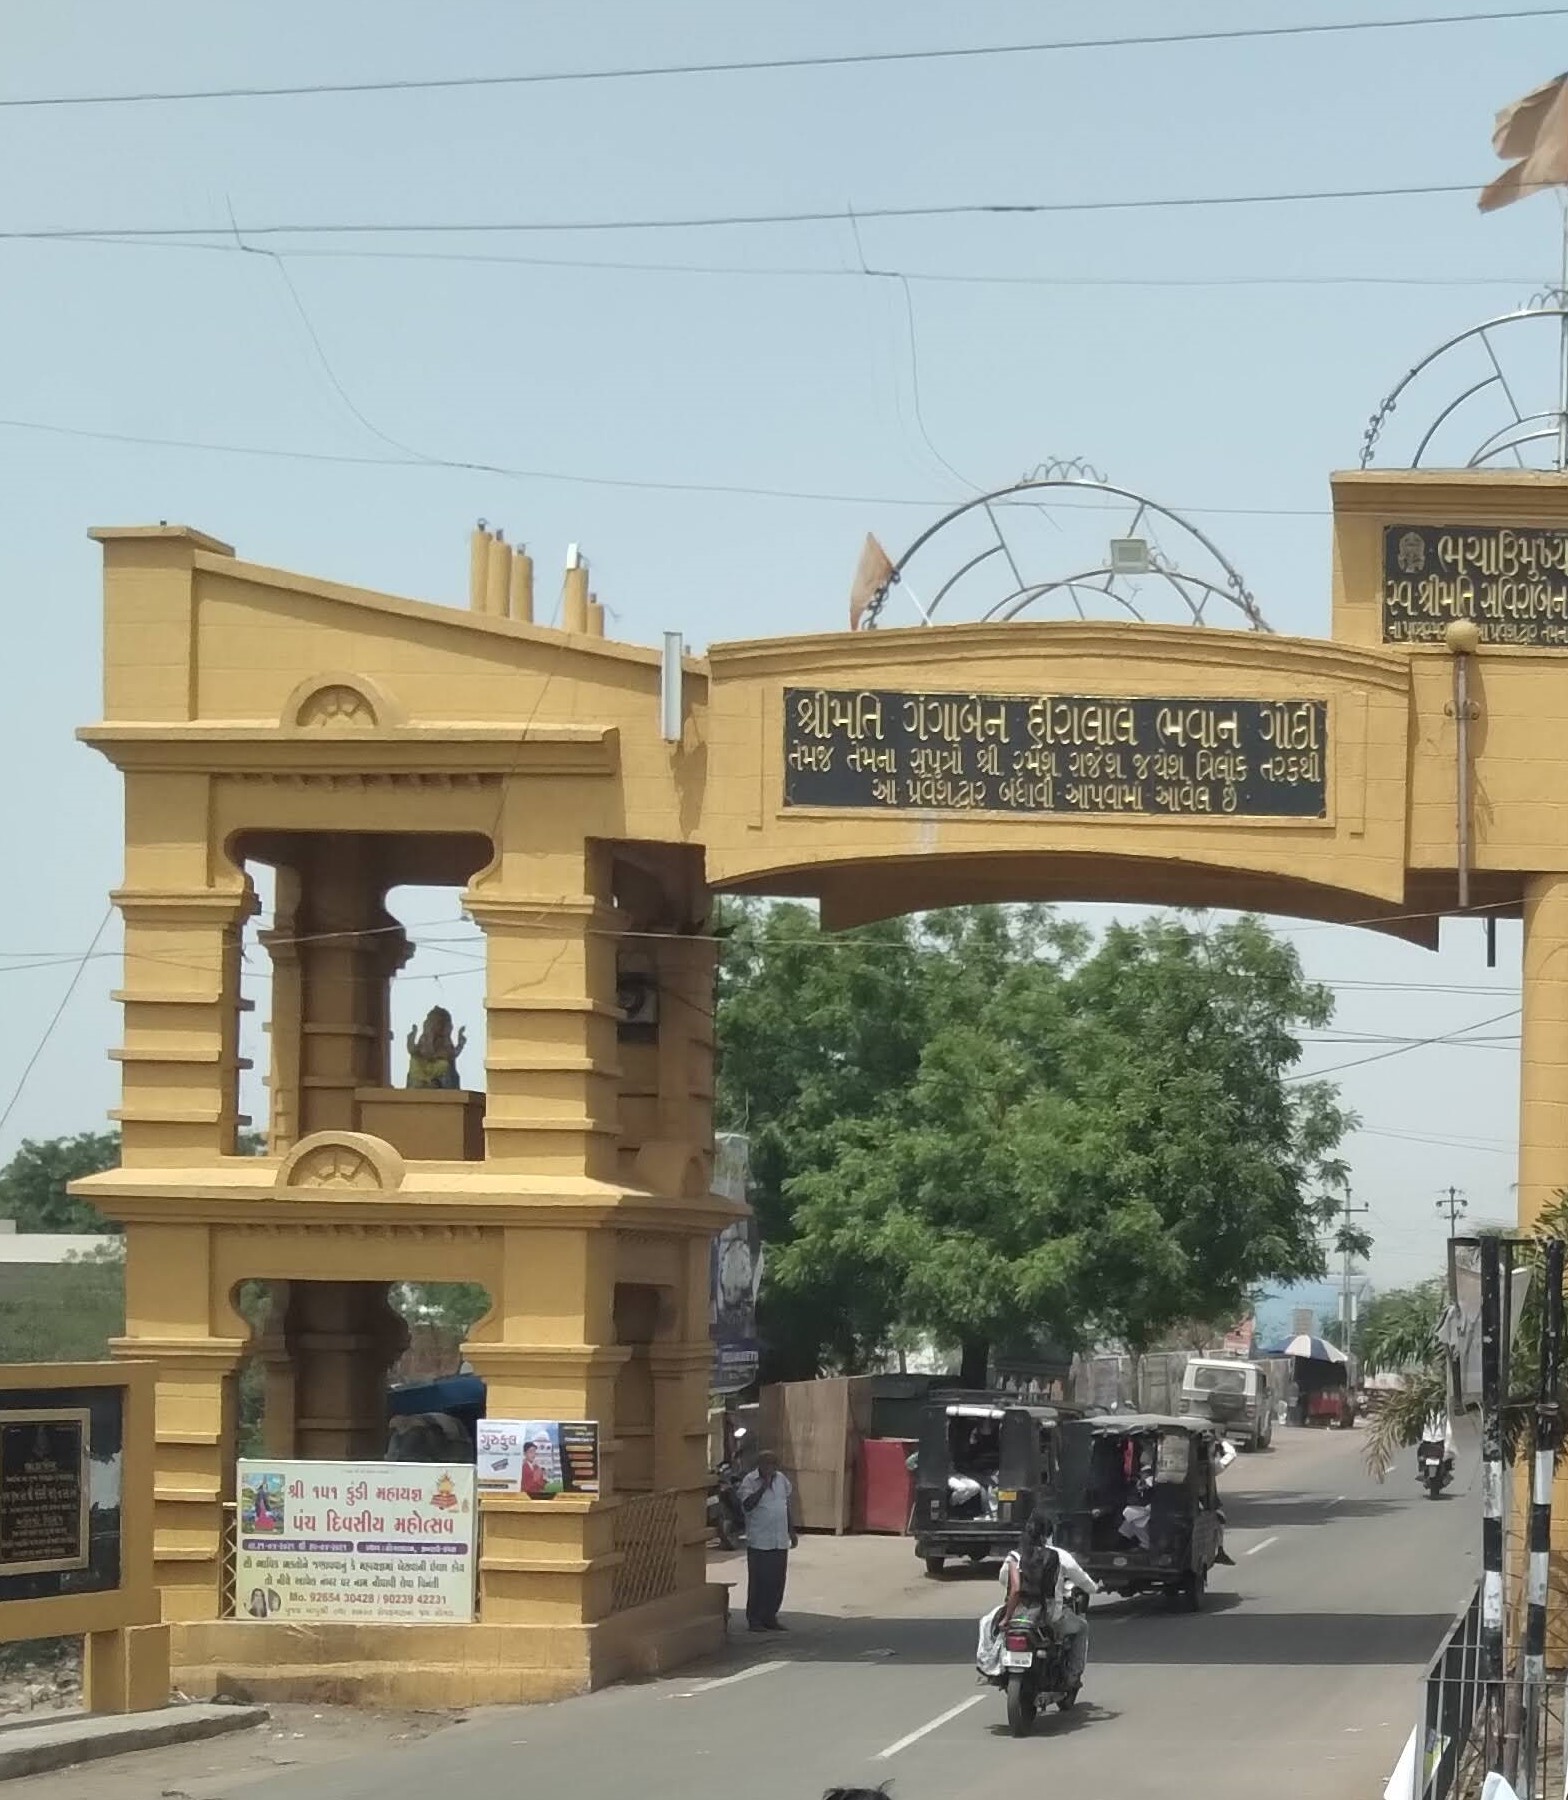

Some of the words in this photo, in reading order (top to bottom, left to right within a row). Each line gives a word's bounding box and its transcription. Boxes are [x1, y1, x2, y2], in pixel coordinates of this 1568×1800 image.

[1418, 573, 1477, 617] શ્રીમતિ
[797, 690, 885, 741] શ્રીમતિ
[902, 694, 1011, 744] ગંગાબેન
[1026, 696, 1140, 749] હીરાલાલ
[1156, 706, 1242, 749] ભવાન
[788, 739, 835, 774] તેમજ
[846, 740, 897, 775] તેમના
[909, 743, 964, 779] સુપુત્રો
[976, 743, 1004, 778] શ્રી
[1011, 744, 1062, 779] રમેશ
[1068, 746, 1127, 780] રાજેશ
[1259, 752, 1322, 787] તરફથી
[871, 777, 898, 805] આ
[998, 776, 1056, 810] બંધાવી
[1064, 781, 1144, 811] આપવામાં
[1154, 780, 1213, 812] આવેલ
[1221, 780, 1239, 813] છે
[287, 1479, 304, 1500] શ્રી
[346, 1480, 368, 1507] કુંડી
[376, 1486, 423, 1502] મહાયજ્ઞ
[293, 1508, 316, 1532] પંચ
[326, 1508, 385, 1533] દિવસીય
[393, 1509, 455, 1535] મહોત્સવ
[289, 1592, 307, 1602] Mo.
